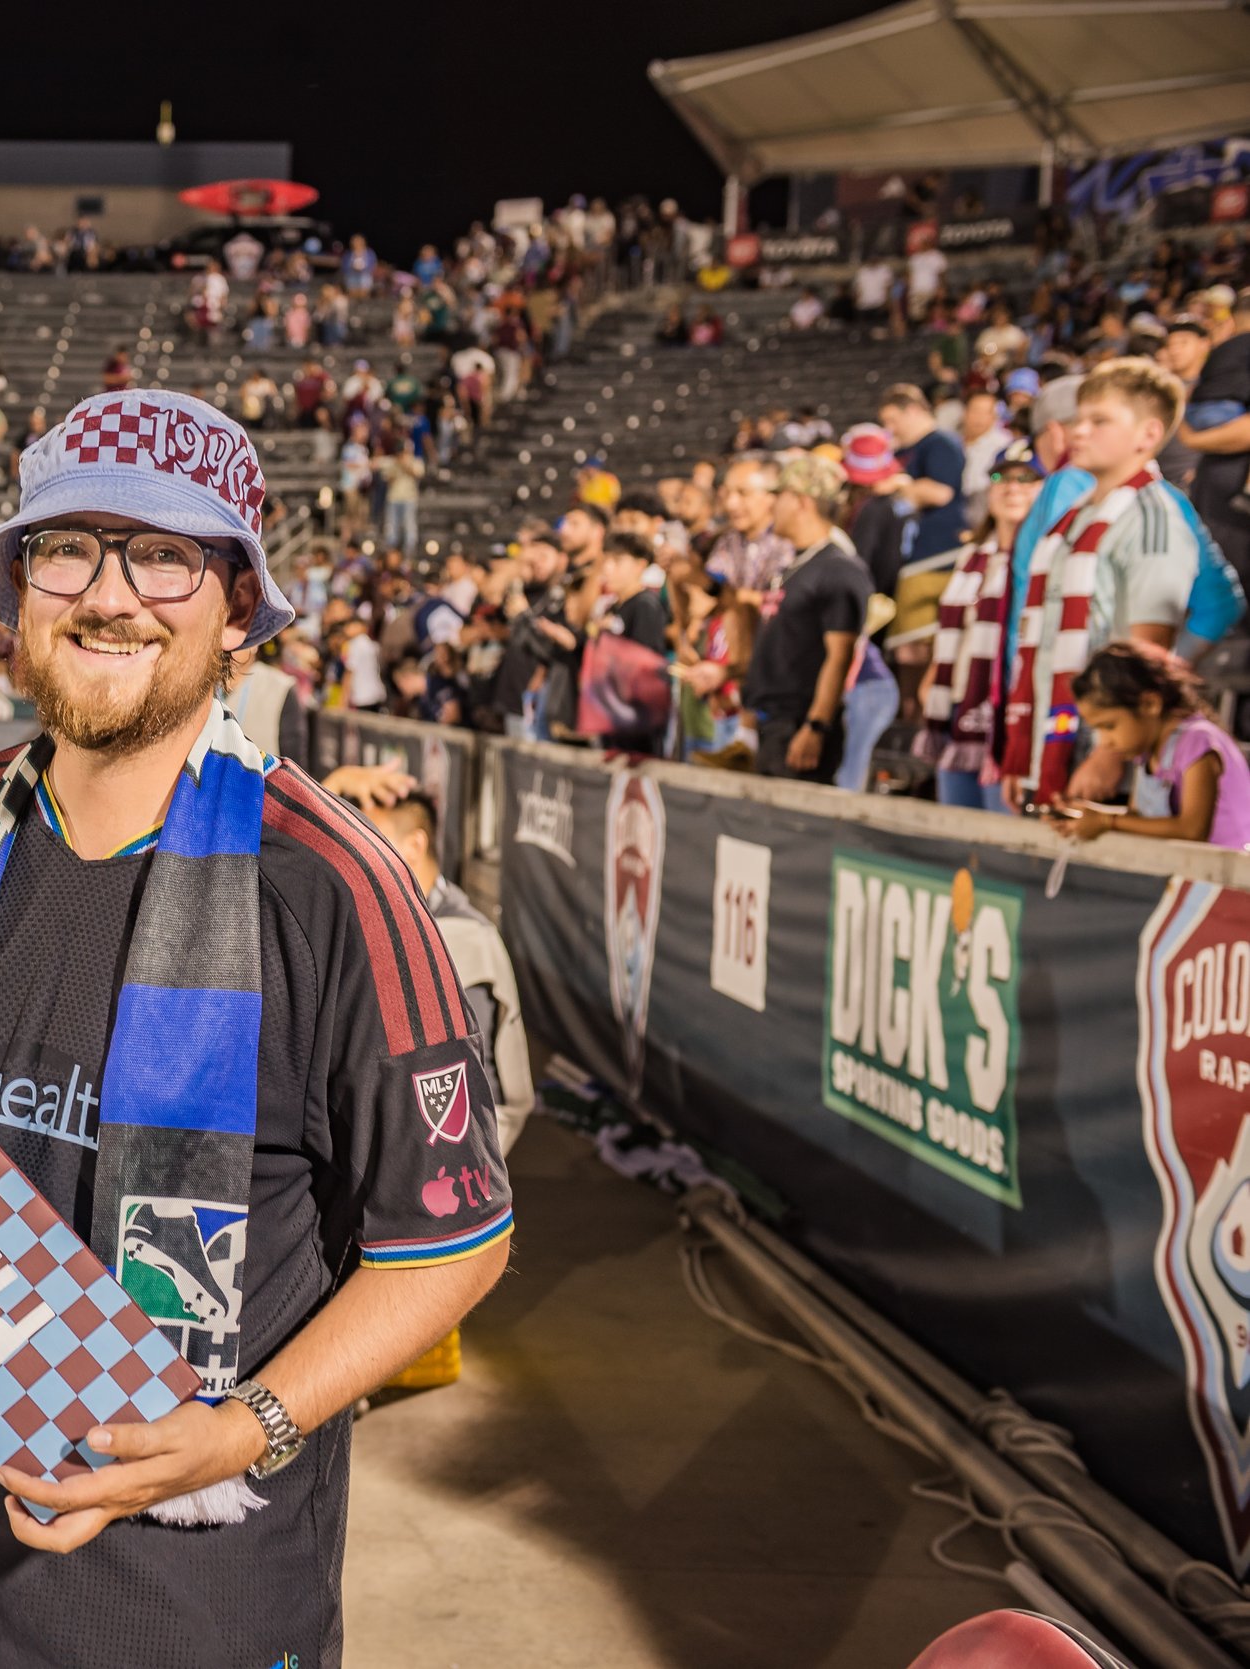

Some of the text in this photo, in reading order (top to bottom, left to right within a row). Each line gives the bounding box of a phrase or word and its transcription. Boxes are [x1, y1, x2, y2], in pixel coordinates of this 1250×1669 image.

[150, 410, 250, 503] 1996
[723, 879, 758, 968] 116
[831, 867, 1012, 1114] DICK'S
[1172, 940, 1250, 1052] COLO
[421, 1074, 454, 1098] MLS
[831, 1050, 924, 1133] SPORTING
[459, 1164, 493, 1208] tv
